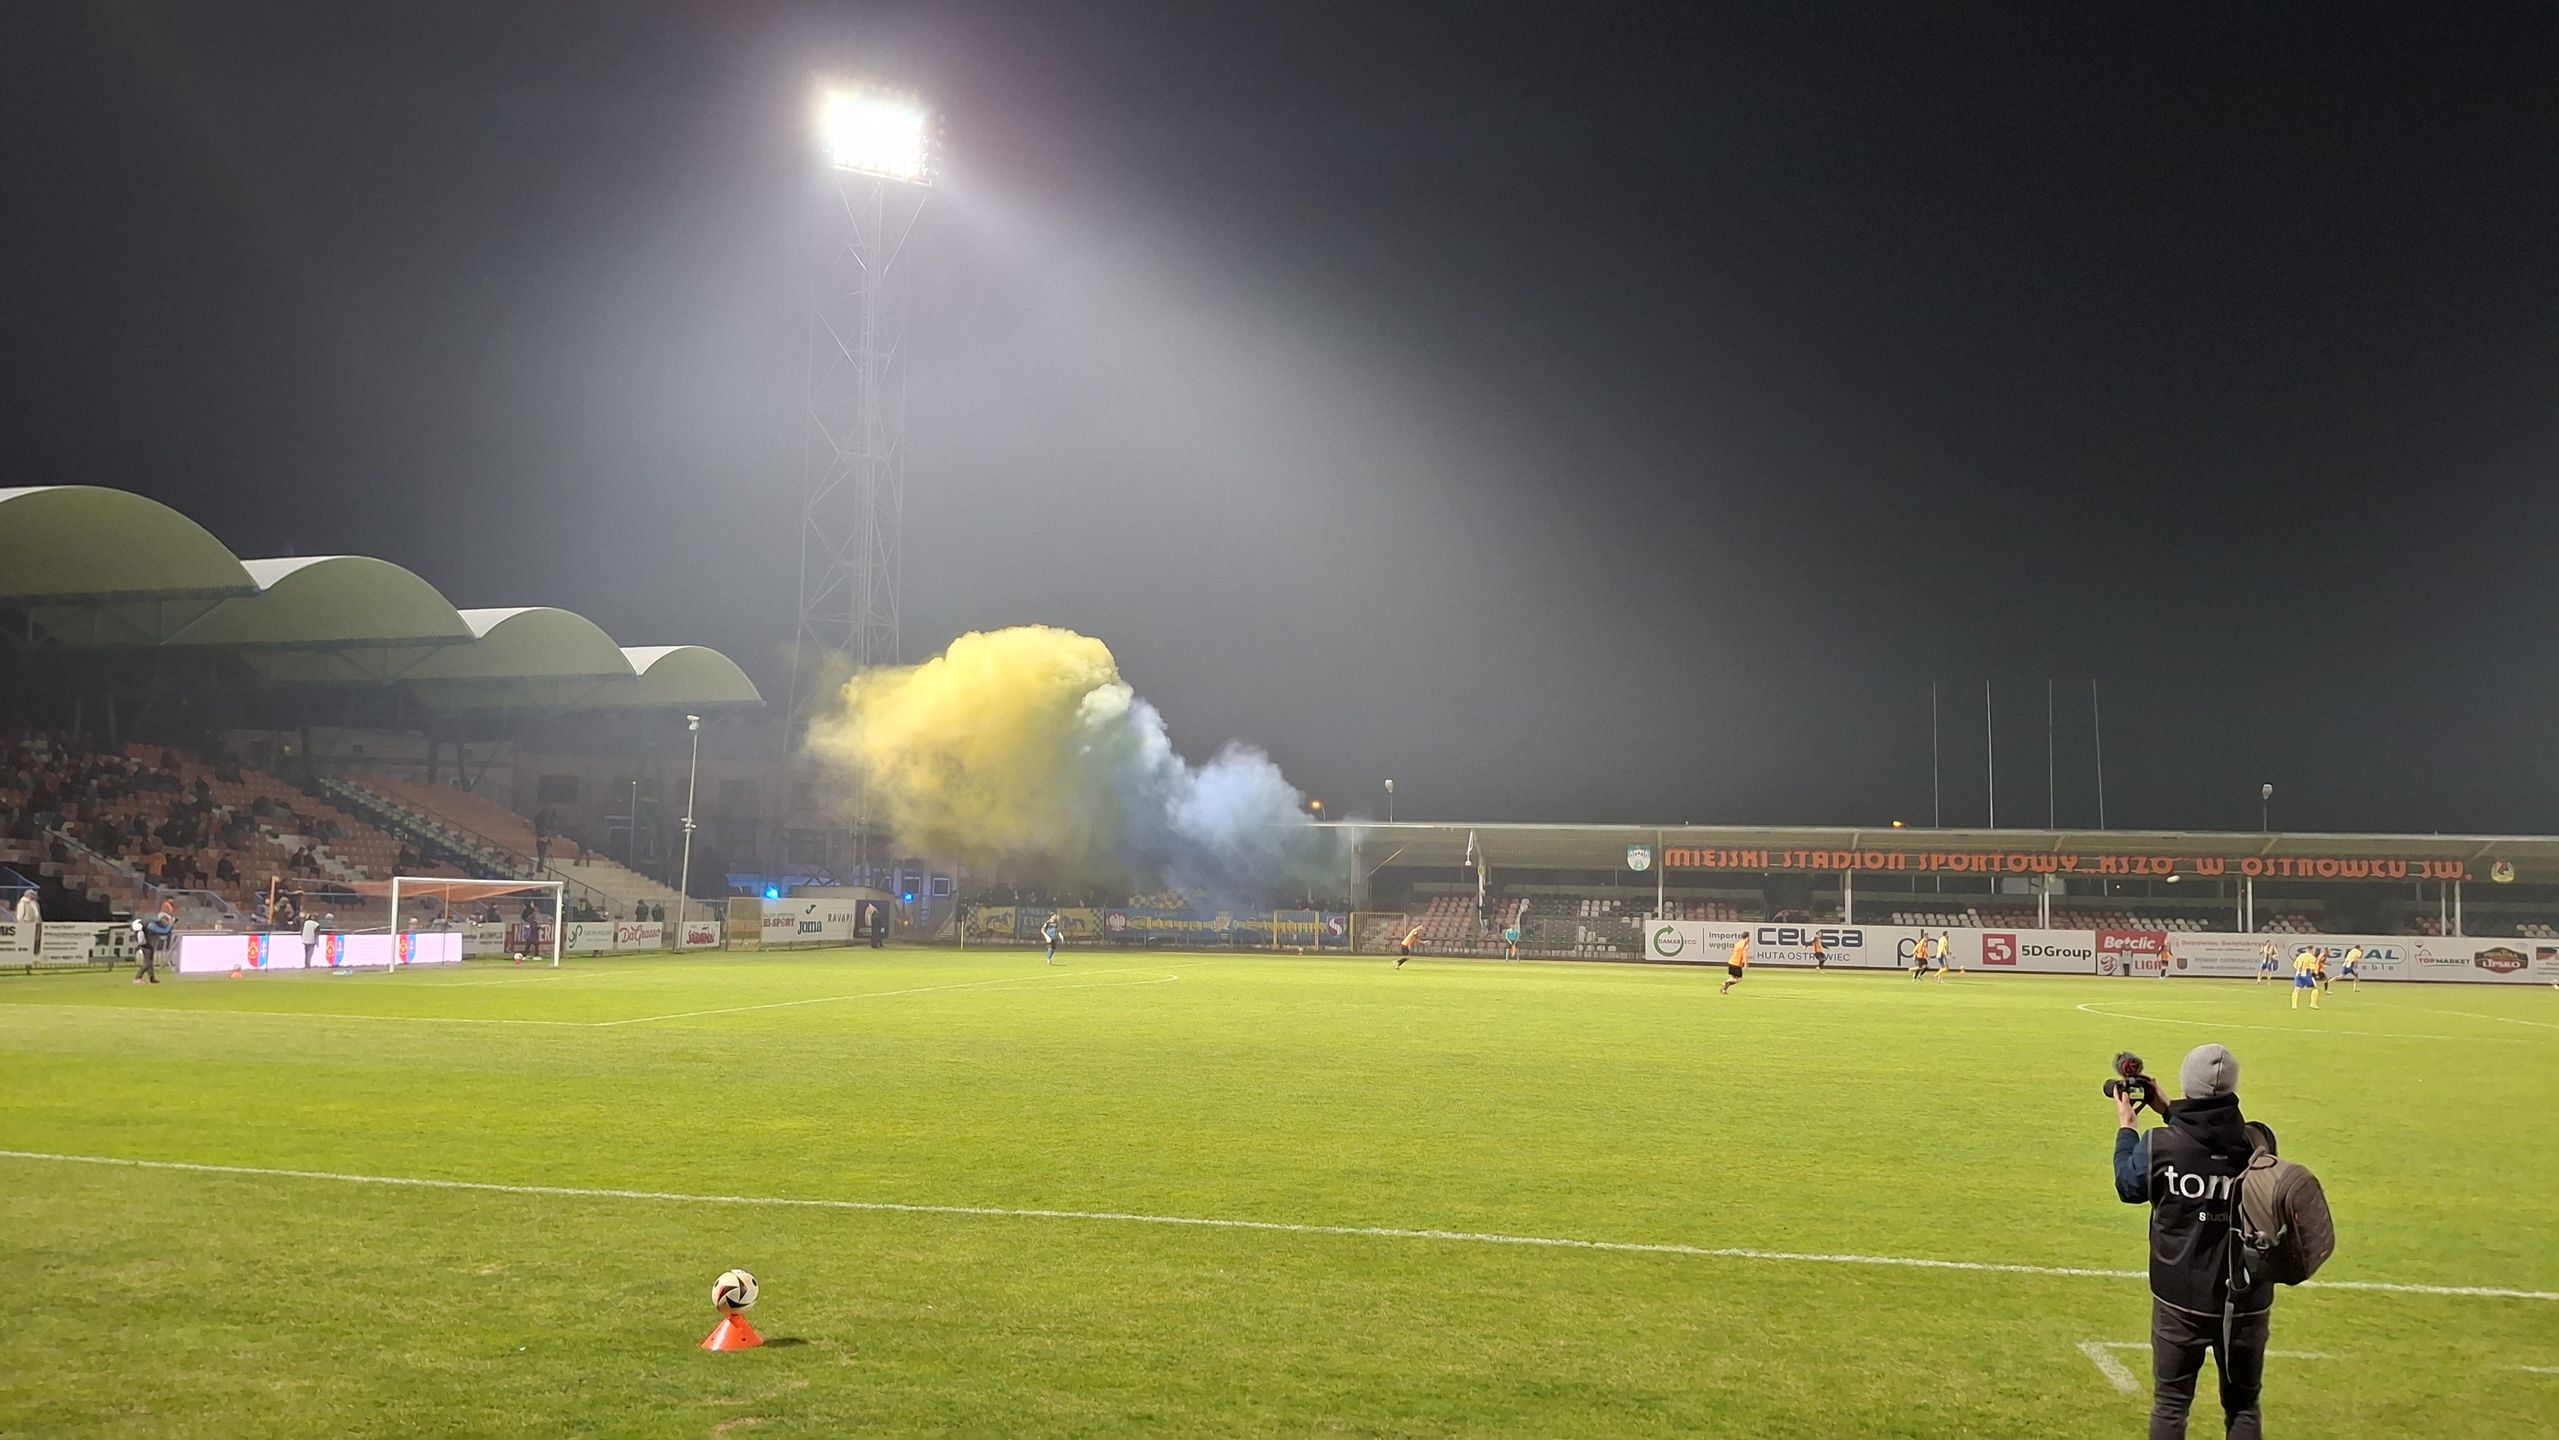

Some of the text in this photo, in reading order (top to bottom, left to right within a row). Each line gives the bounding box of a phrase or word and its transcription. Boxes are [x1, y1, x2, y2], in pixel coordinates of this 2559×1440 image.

[1664, 848, 1769, 868] MIEJSKI
[1781, 850, 1906, 870] STADION
[1918, 852, 2079, 873] SPORTOWY
[2196, 857, 2225, 876] W
[2240, 858, 2408, 878] OSTROWCU
[1757, 952, 1851, 962] HUTA OSTRWIEC
[2022, 945, 2092, 960] 5DGroup
